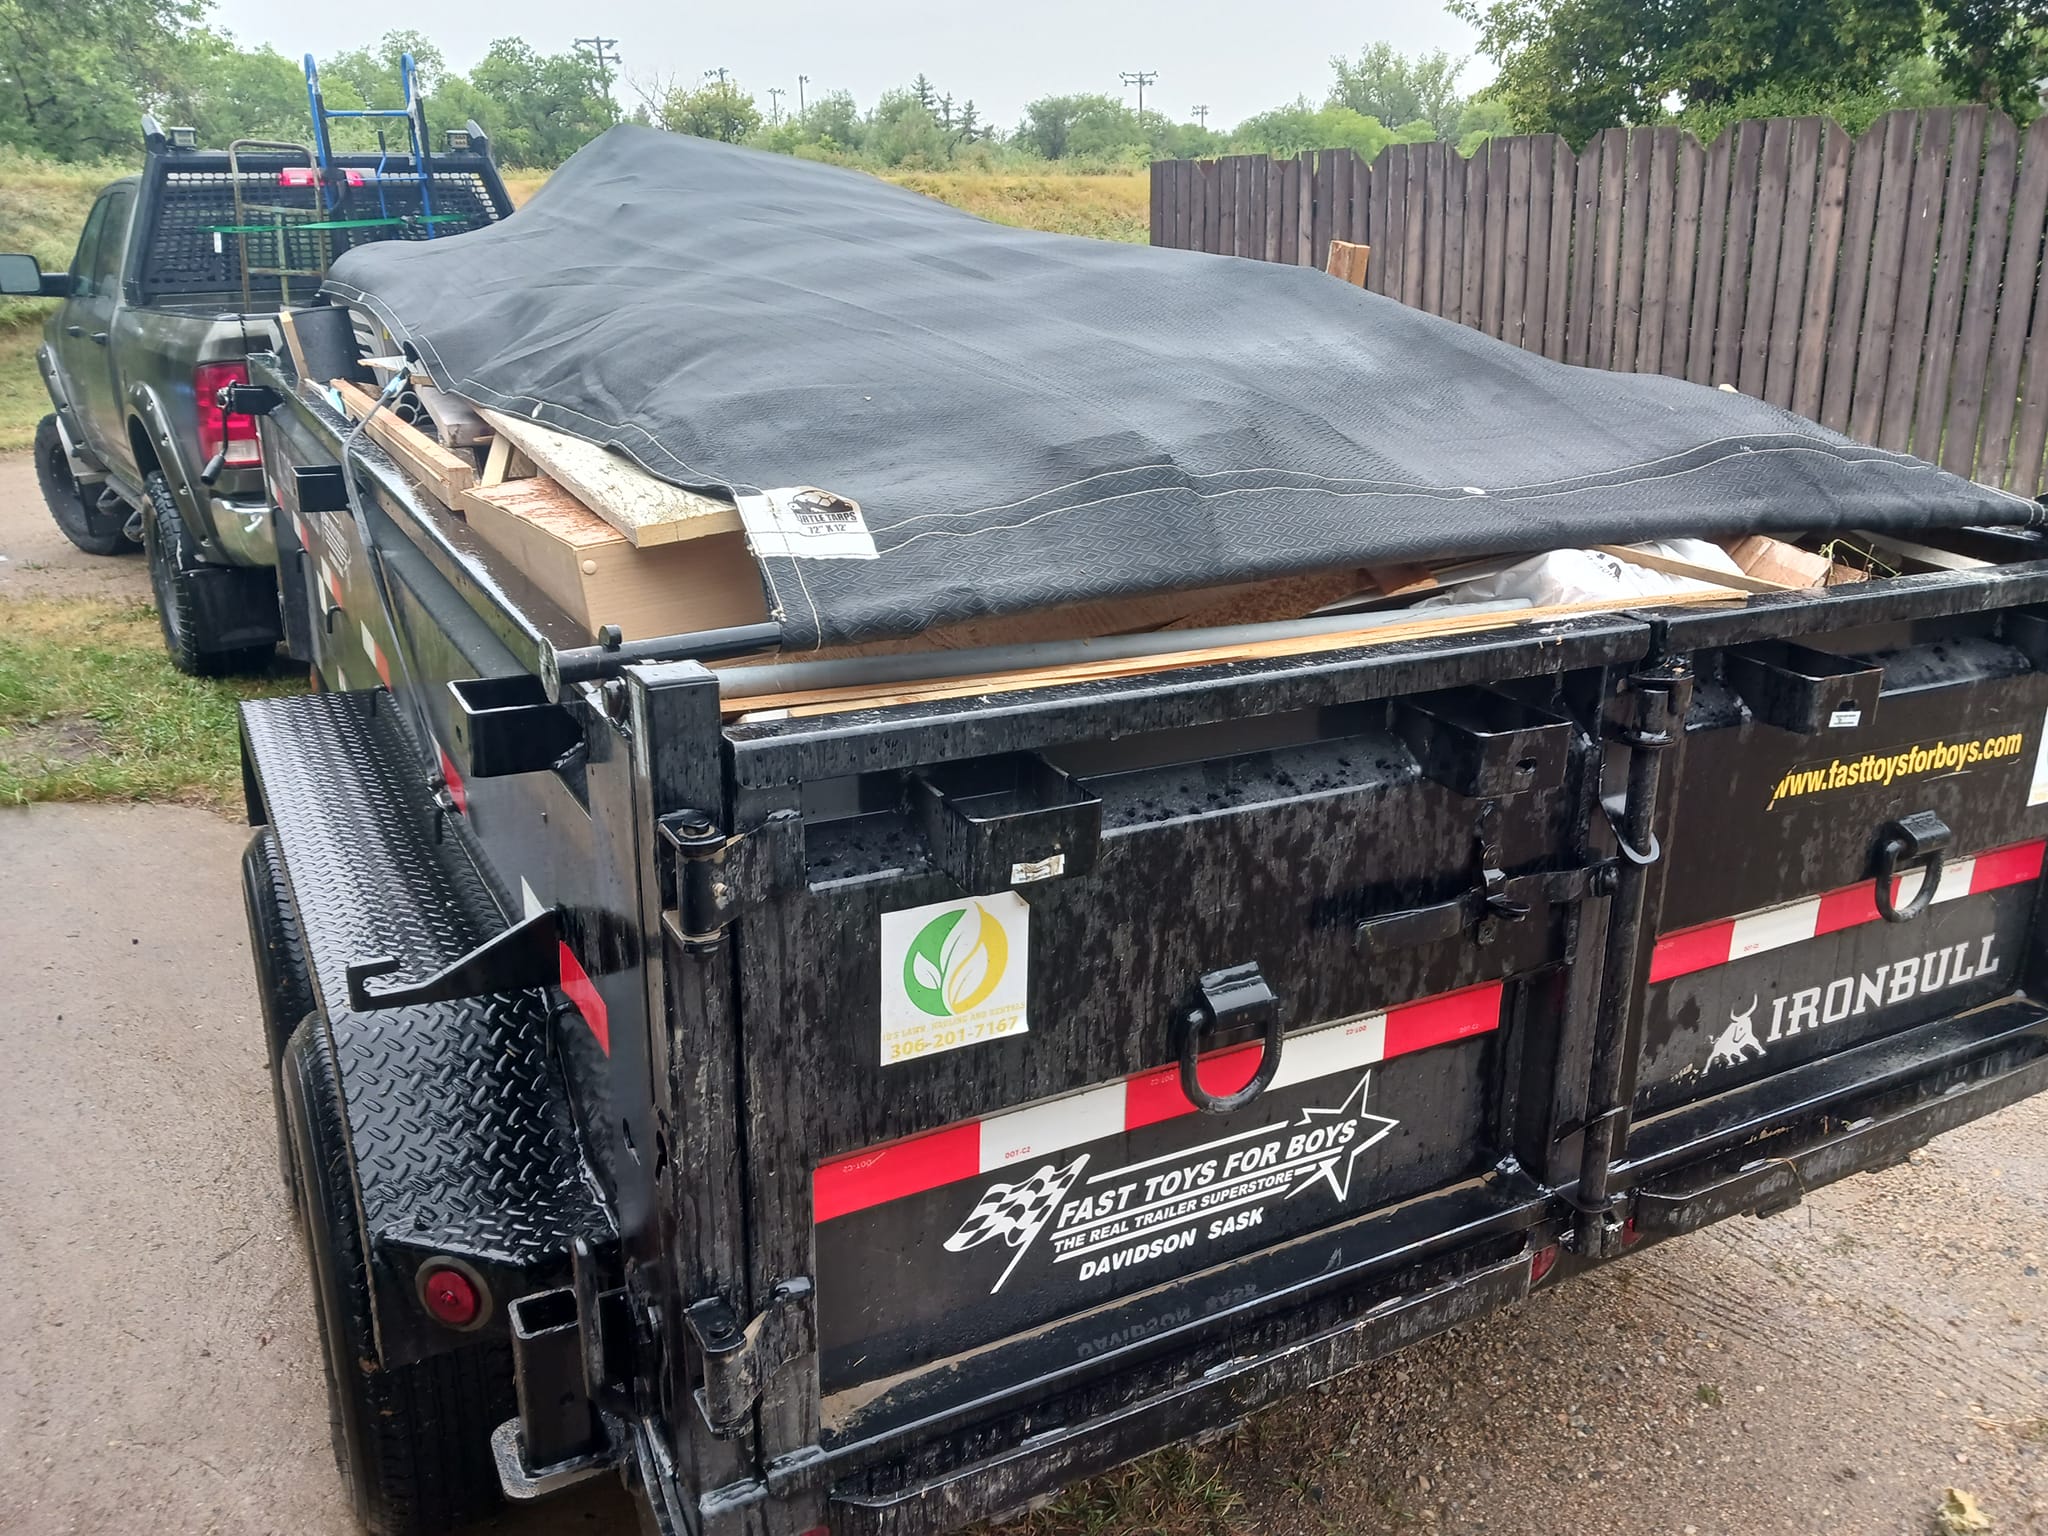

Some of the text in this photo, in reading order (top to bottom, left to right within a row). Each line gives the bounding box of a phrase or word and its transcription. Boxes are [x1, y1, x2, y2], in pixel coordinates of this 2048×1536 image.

[825, 511, 857, 521] TARPS
[1773, 733, 2023, 800] www.fasttoysforboys.com
[1766, 933, 2000, 1043] IRONBULL
[890, 1015, 1018, 1059] 306-201-7167
[1053, 1168, 1294, 1254] THE REAL TRAILER SUPERSTORE
[1057, 1119, 1358, 1228] FAST TOYS FOR BOYS
[1078, 1207, 1265, 1282] DAVIDSON SASK
